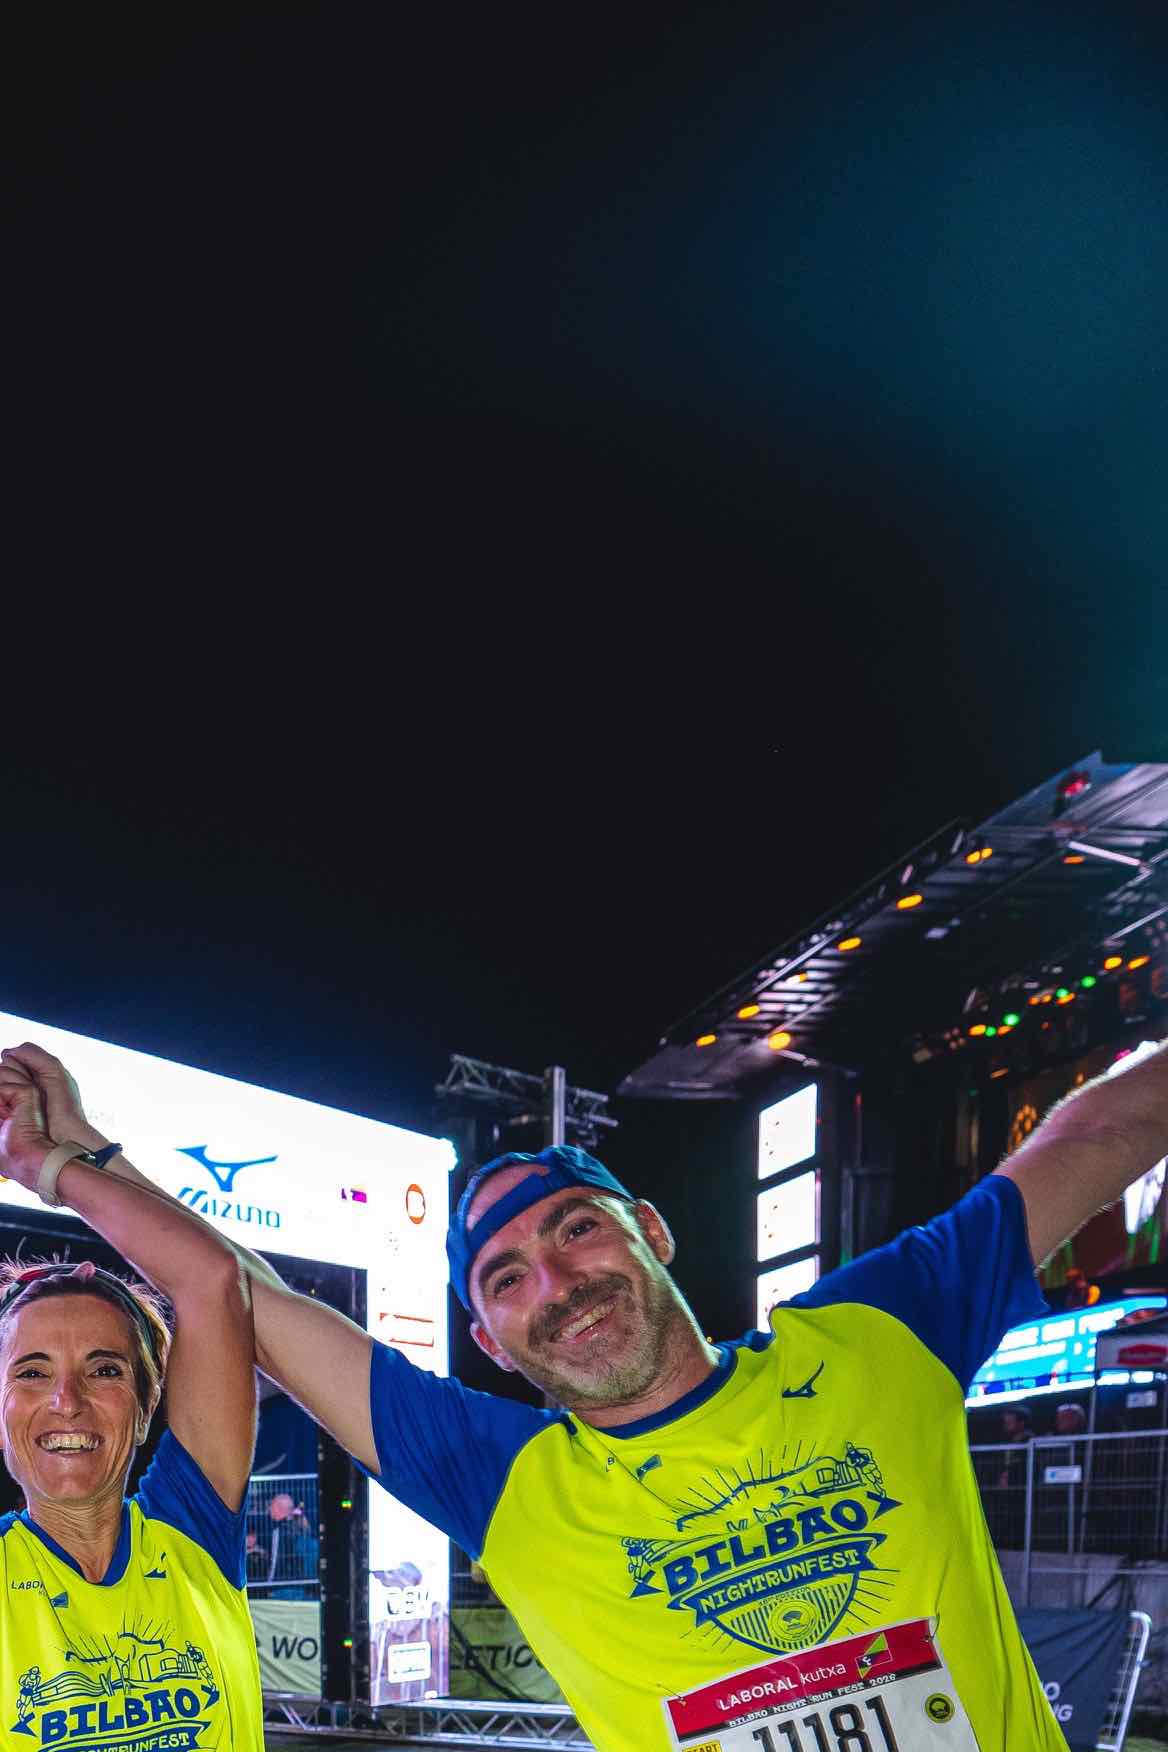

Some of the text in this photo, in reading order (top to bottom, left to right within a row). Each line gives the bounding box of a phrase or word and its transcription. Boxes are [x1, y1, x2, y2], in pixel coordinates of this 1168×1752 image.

[176, 1187, 281, 1229] MIZUNO
[662, 1498, 868, 1597] BILBAO
[701, 1549, 862, 1614] NIGHTRUNFEST
[720, 1662, 847, 1711] LABORAL kutxa
[41, 1687, 201, 1745] BILBAO
[728, 1709, 768, 1728] BILBAO
